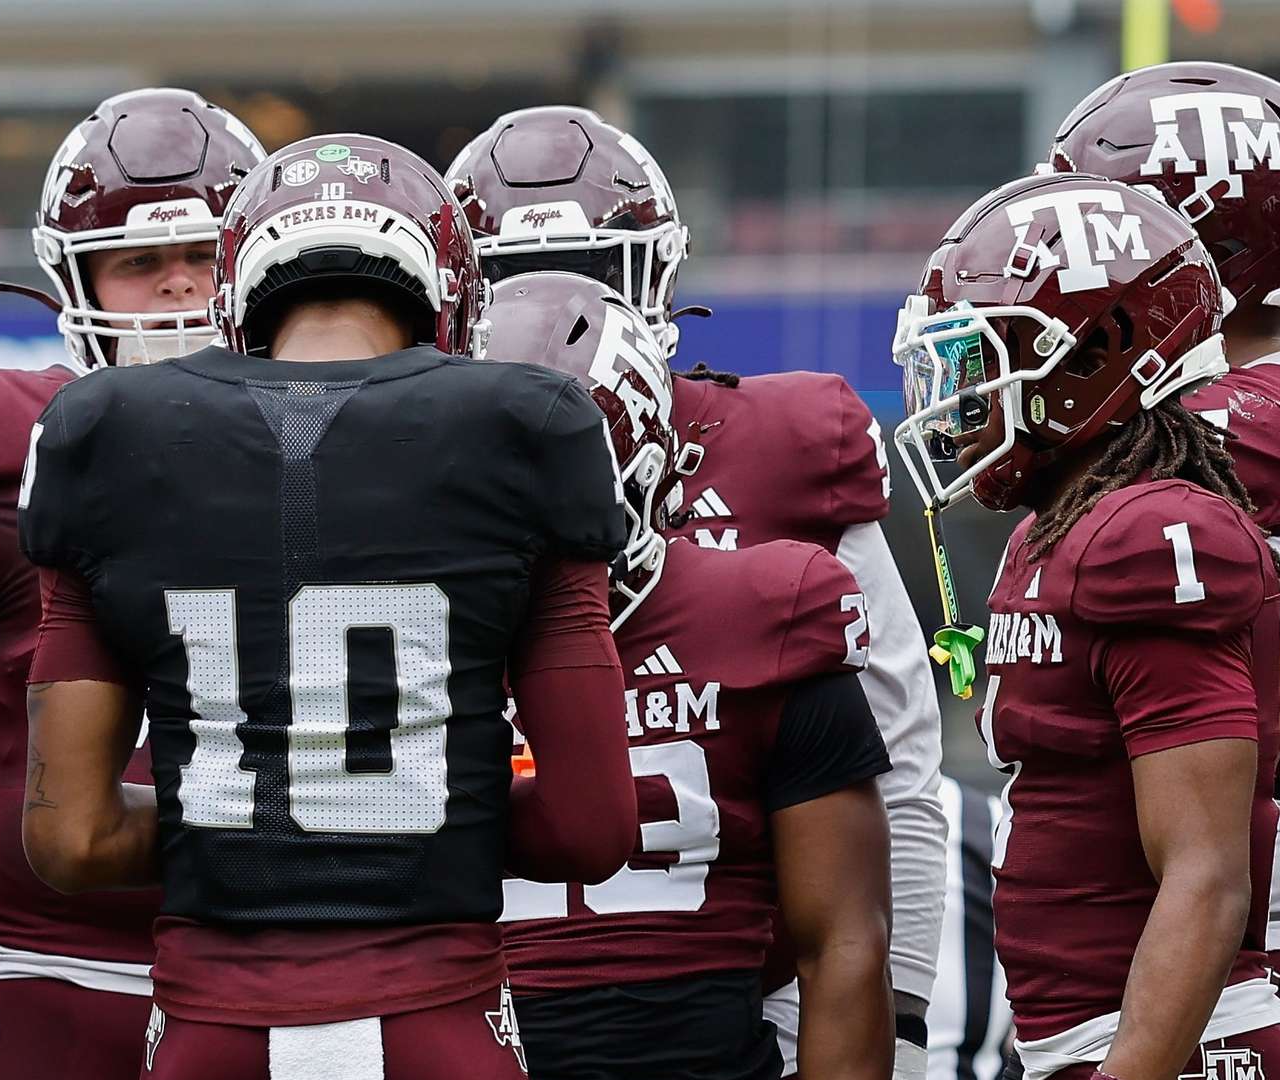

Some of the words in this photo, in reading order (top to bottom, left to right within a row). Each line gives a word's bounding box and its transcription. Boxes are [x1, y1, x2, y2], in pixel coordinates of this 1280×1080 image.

[284, 161, 317, 184] SEC
[321, 183, 345, 200] 10
[147, 204, 189, 223] Aggies
[280, 206, 337, 229] TEXAS
[343, 206, 378, 223] A&M
[520, 208, 563, 229] Aggies
[1163, 522, 1206, 603] 1
[163, 584, 451, 834] 10
